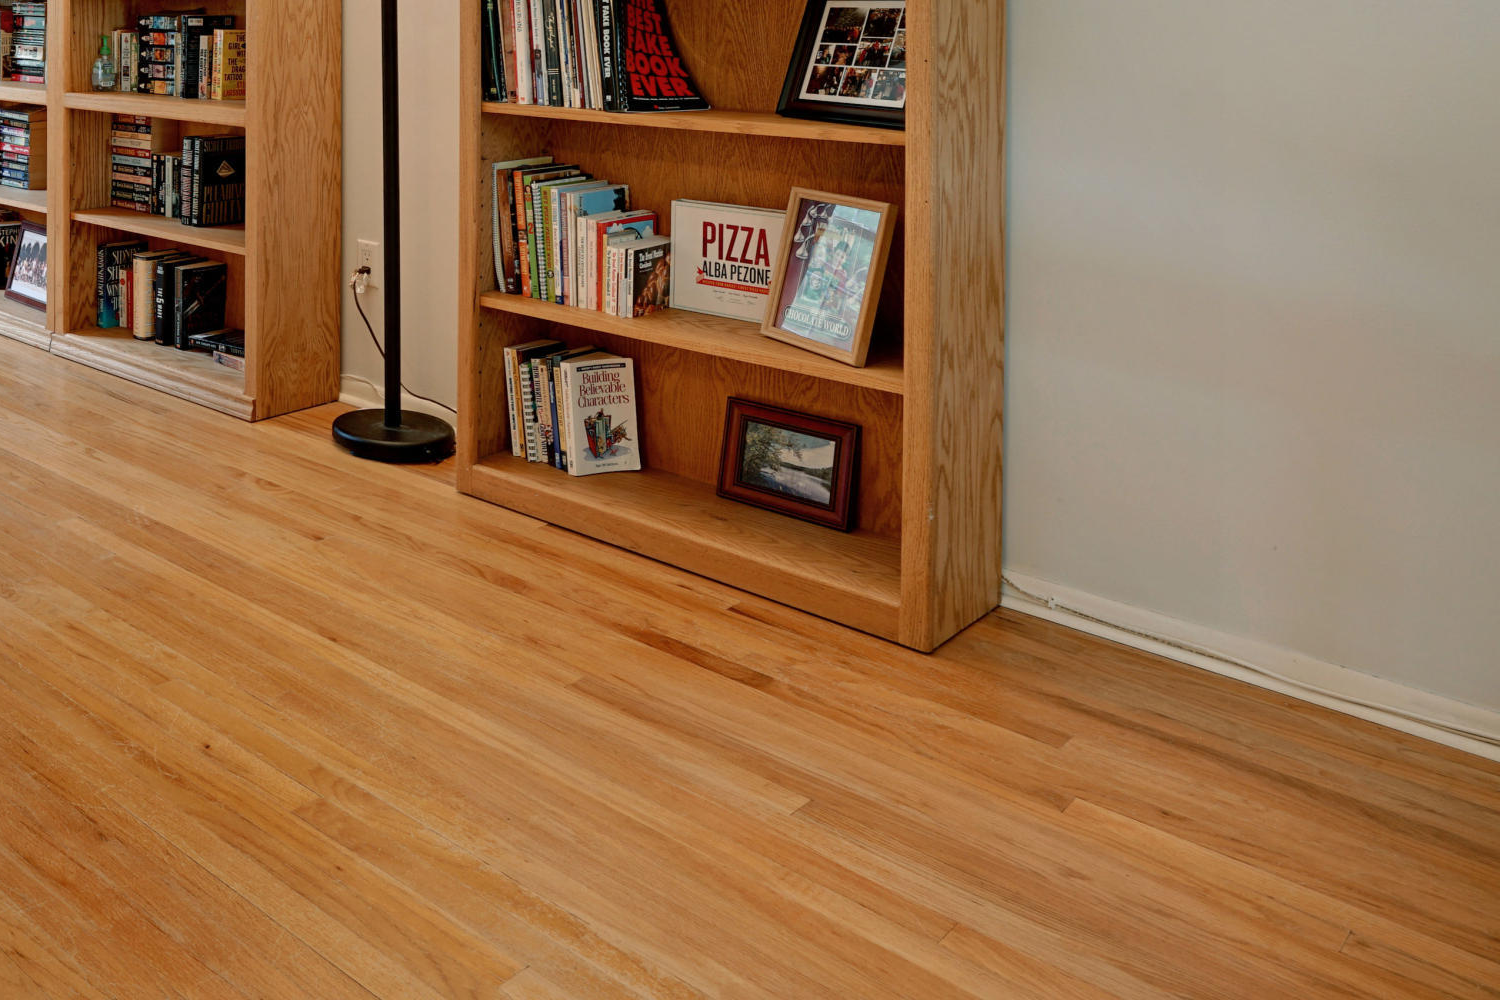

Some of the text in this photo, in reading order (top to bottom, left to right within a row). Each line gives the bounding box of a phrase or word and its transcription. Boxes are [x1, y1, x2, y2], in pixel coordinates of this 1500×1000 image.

[602, 5, 610, 27] FAKE
[627, 3, 662, 35] BEST
[603, 28, 611, 55] BOOK
[627, 28, 674, 58] FAKE
[626, 49, 689, 78] BOOK
[629, 76, 696, 97] EVER
[702, 221, 771, 267] PIZZA
[703, 260, 728, 280] ALBA
[730, 263, 772, 287] PEZONE
[579, 383, 626, 397] Believable
[582, 371, 621, 384] Building
[578, 394, 630, 408] Characters
